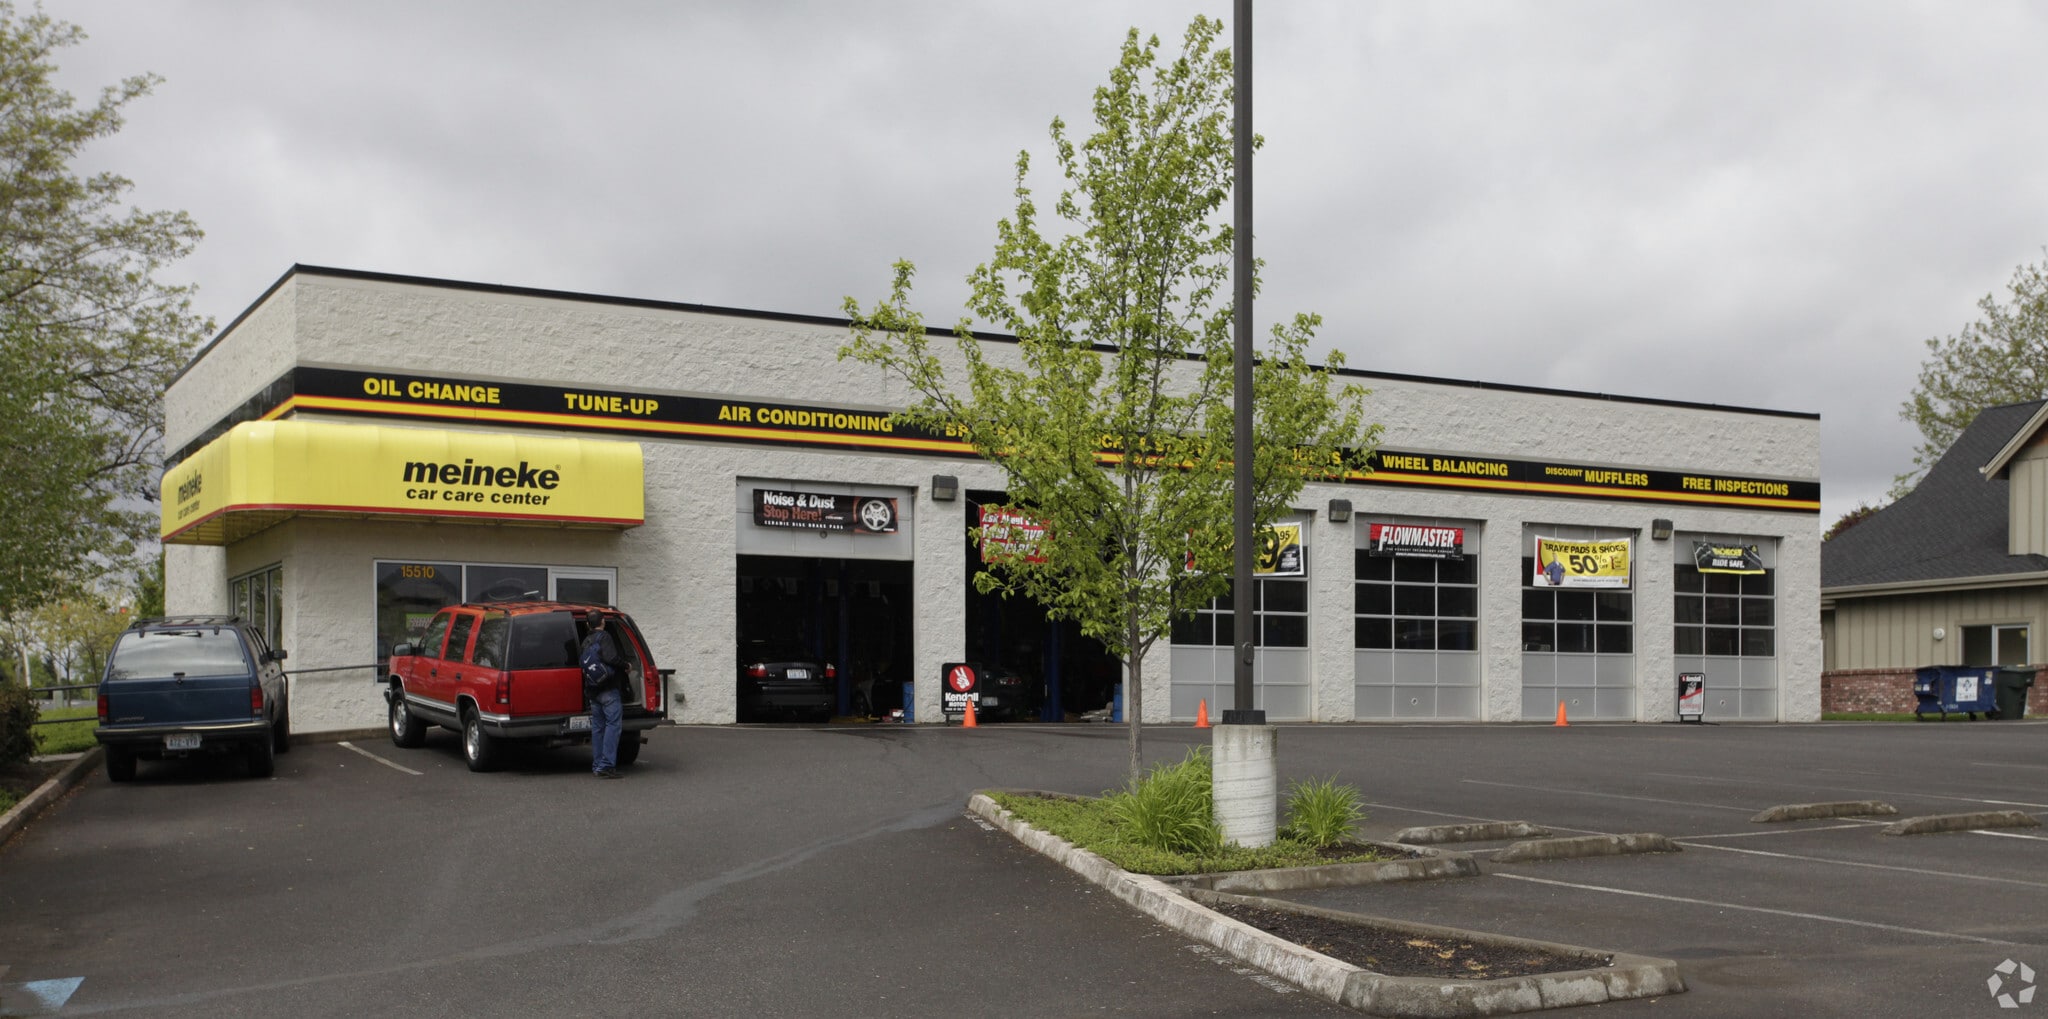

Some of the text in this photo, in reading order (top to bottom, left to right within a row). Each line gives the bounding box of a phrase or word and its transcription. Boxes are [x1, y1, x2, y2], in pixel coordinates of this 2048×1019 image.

[363, 377, 500, 404] OIL CHANGE
[564, 393, 659, 415] TUNE-UP
[718, 405, 893, 432] AIR CONDITIONING
[403, 458, 560, 490] meineke
[1382, 455, 1508, 477] WHEEL BALANCING
[1545, 467, 1649, 486] DISCOUNT MUFFLERS
[1682, 477, 1789, 496] FREE INSPECTIONS
[406, 488, 550, 506] car care center
[763, 491, 835, 509] Noise & Dust
[763, 504, 789, 519] Stop
[792, 507, 822, 521] Here!
[1378, 525, 1455, 551] FLOWMASTER
[1570, 545, 1590, 554] PADS
[1599, 544, 1626, 553] SHOES
[401, 565, 435, 579] 15510
[1712, 558, 1728, 567] RIDE
[945, 692, 979, 702] Kendall
